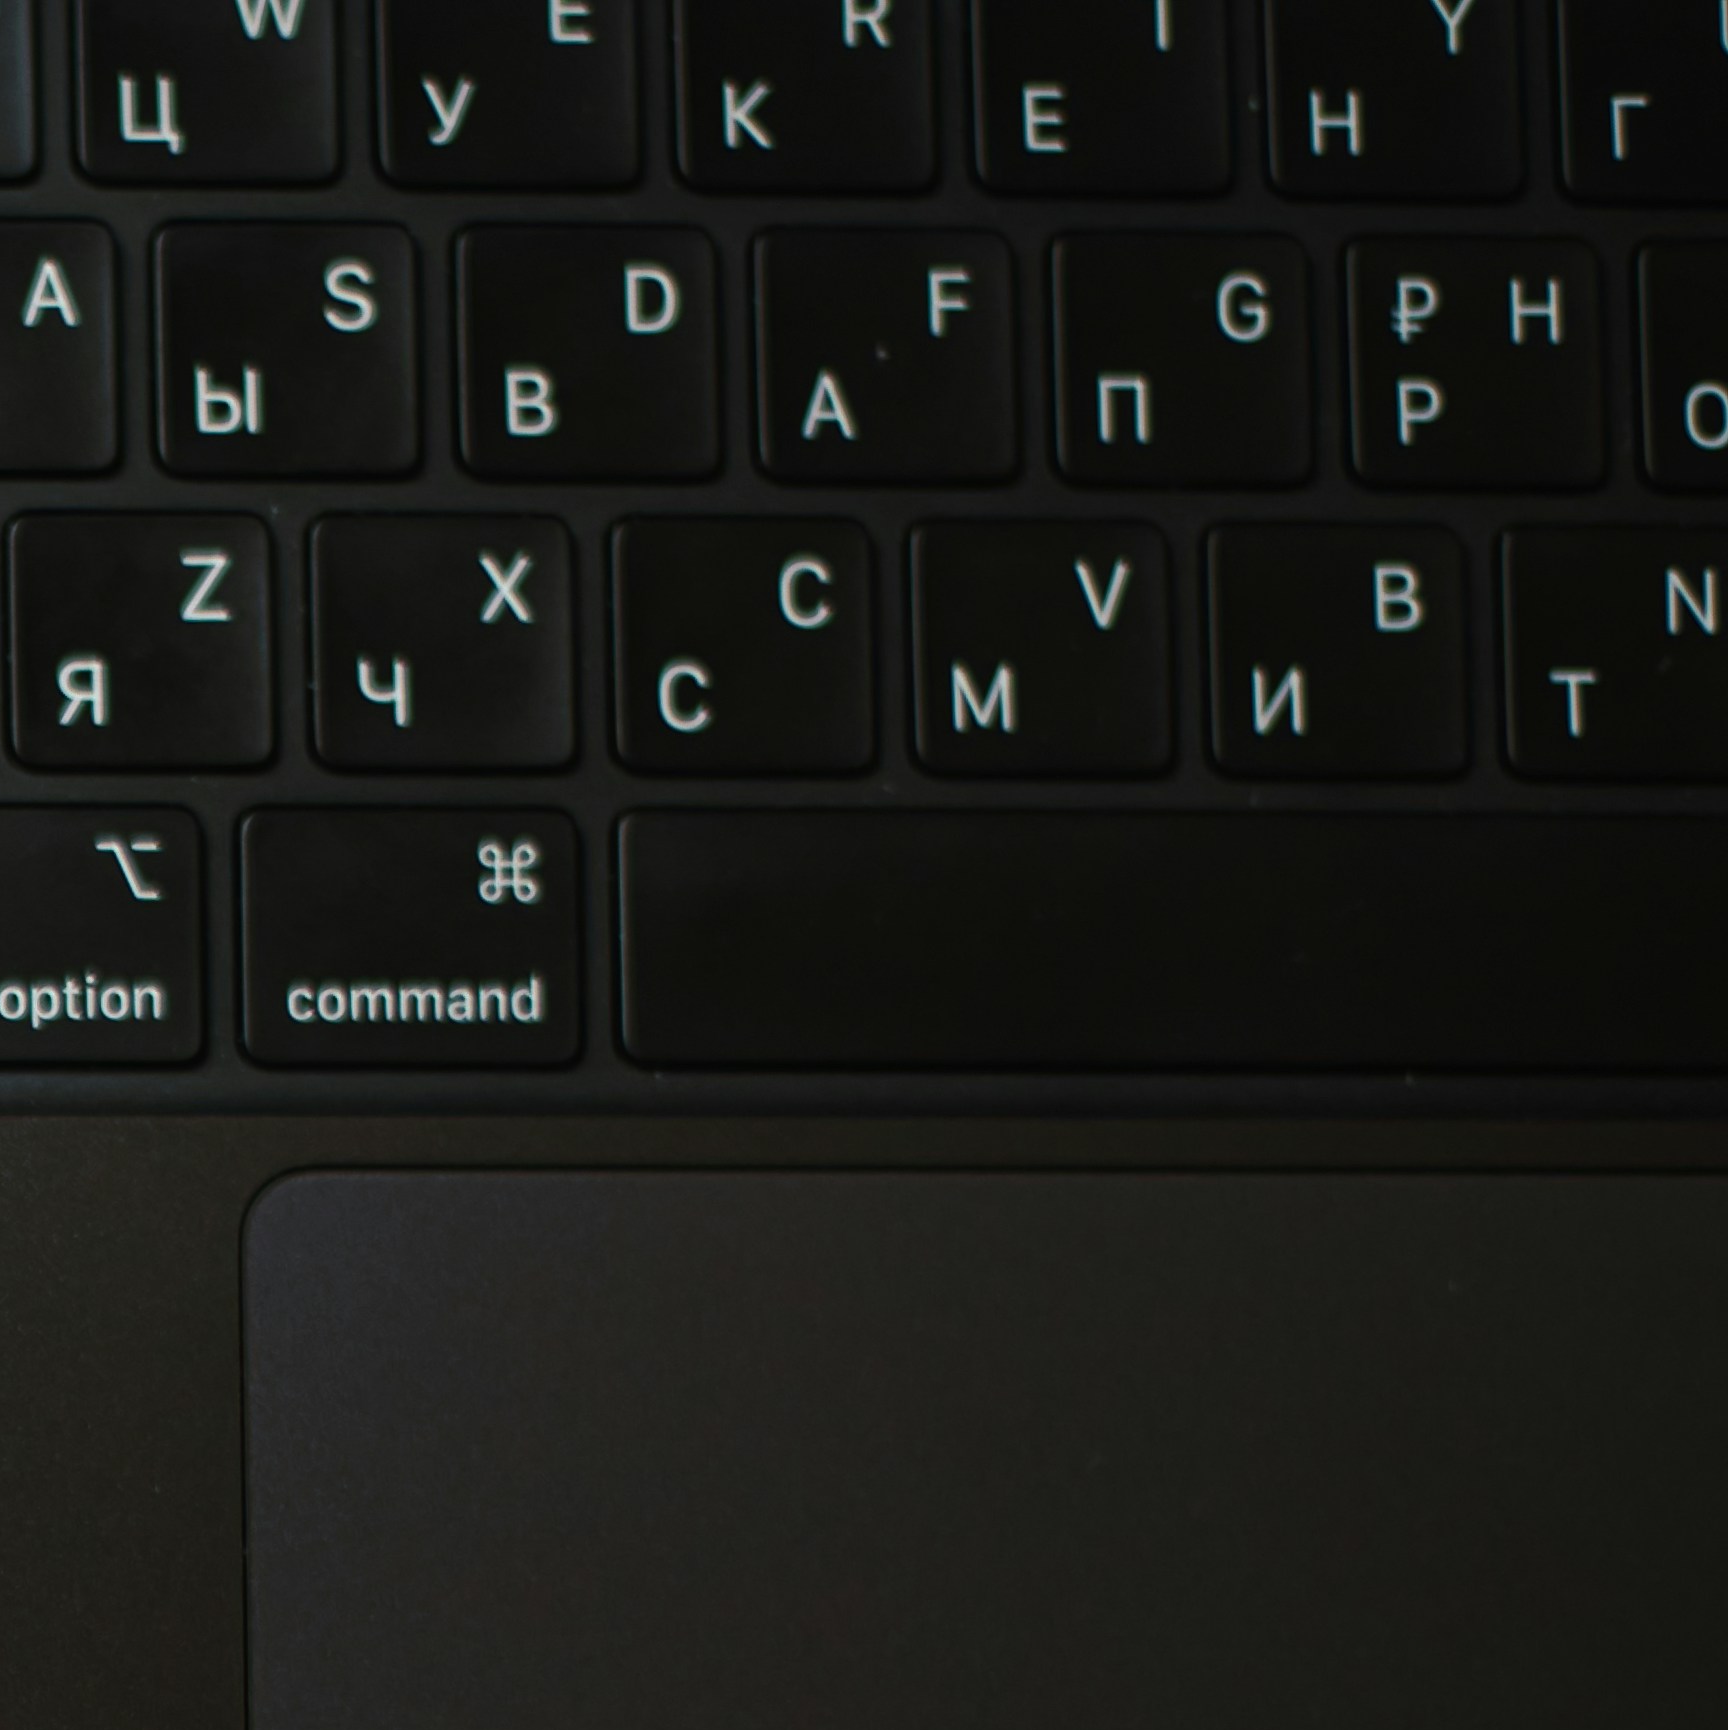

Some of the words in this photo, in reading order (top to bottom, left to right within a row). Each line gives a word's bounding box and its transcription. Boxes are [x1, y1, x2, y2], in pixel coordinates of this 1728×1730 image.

[22, 257, 80, 327] A
[323, 260, 378, 332] S
[624, 266, 680, 334] D
[927, 269, 971, 336] F
[1216, 273, 1270, 343] G
[1509, 279, 1561, 344] H
[180, 549, 234, 623] Z
[478, 553, 534, 624] X
[778, 557, 833, 629] C
[1074, 560, 1131, 630] V
[1373, 564, 1423, 632] B
[1665, 568, 1718, 635] N
[286, 975, 543, 1023] command
